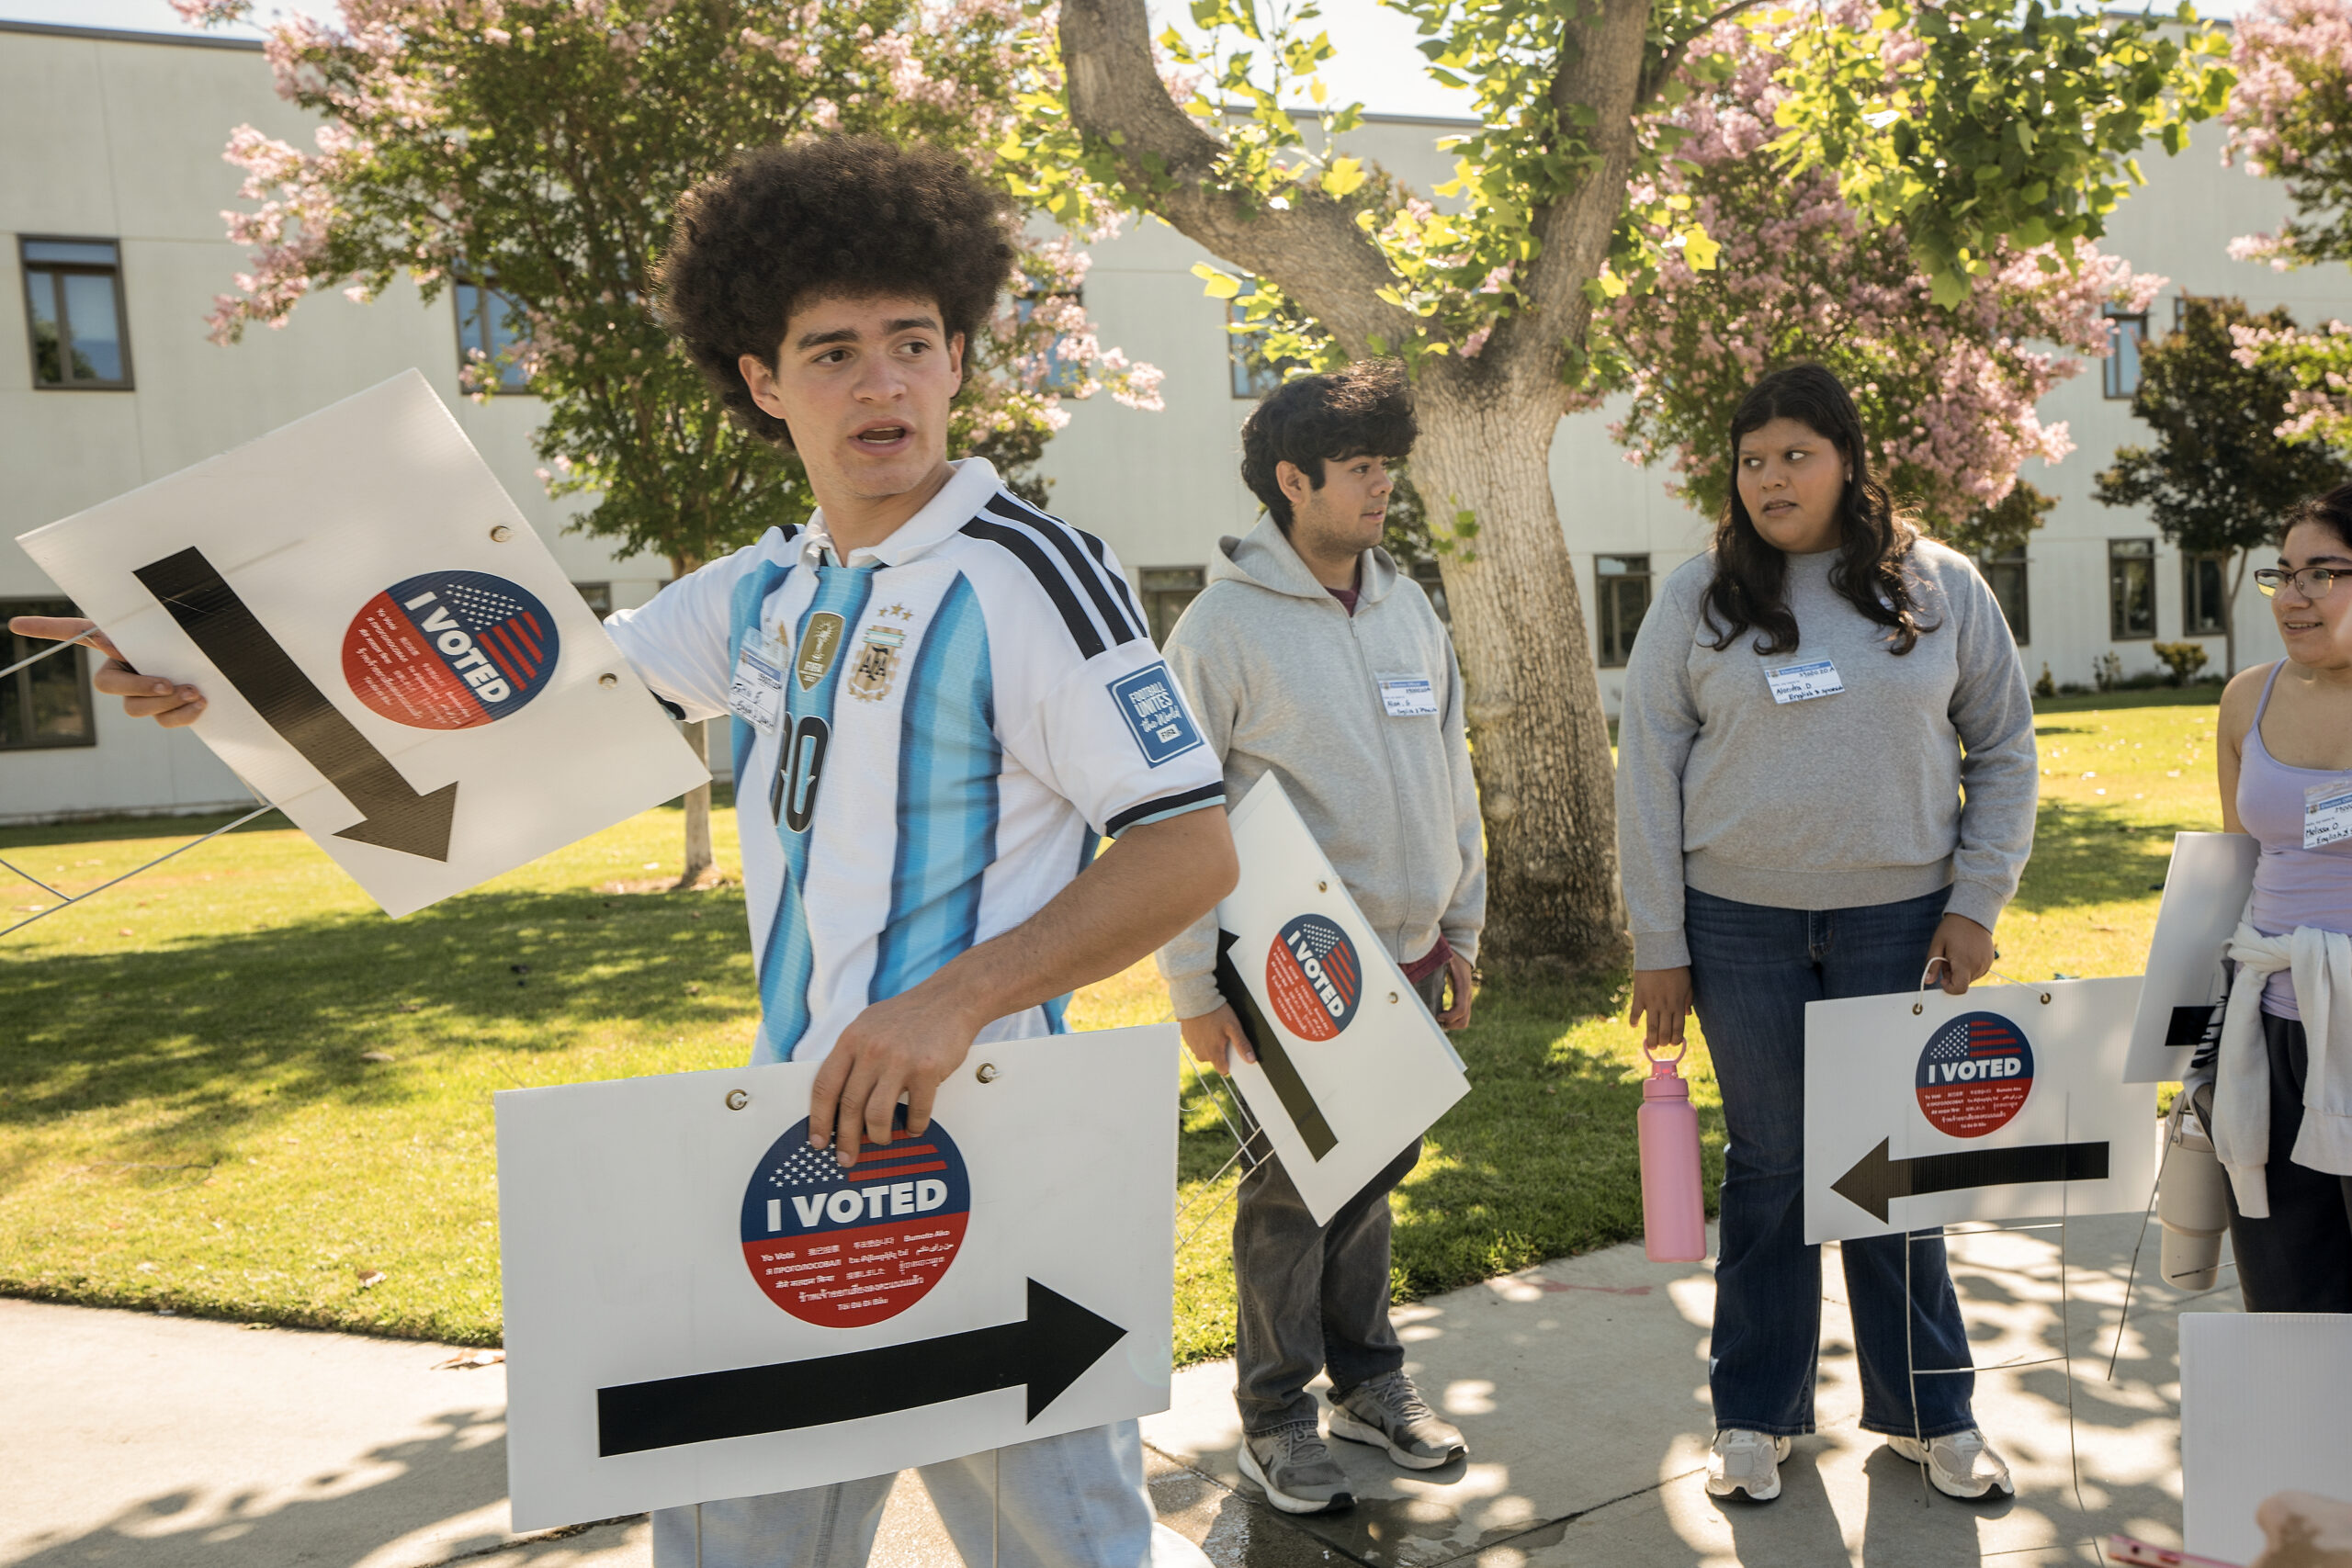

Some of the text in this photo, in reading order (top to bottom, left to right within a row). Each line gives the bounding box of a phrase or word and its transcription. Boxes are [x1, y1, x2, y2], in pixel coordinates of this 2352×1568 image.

[404, 592, 437, 611] I
[421, 605, 511, 703] VOTED
[1287, 930, 1301, 946] I
[1295, 941, 1345, 1018] VOTED
[1928, 1057, 2021, 1084] I VOTED
[767, 1179, 947, 1232] I VOTED
